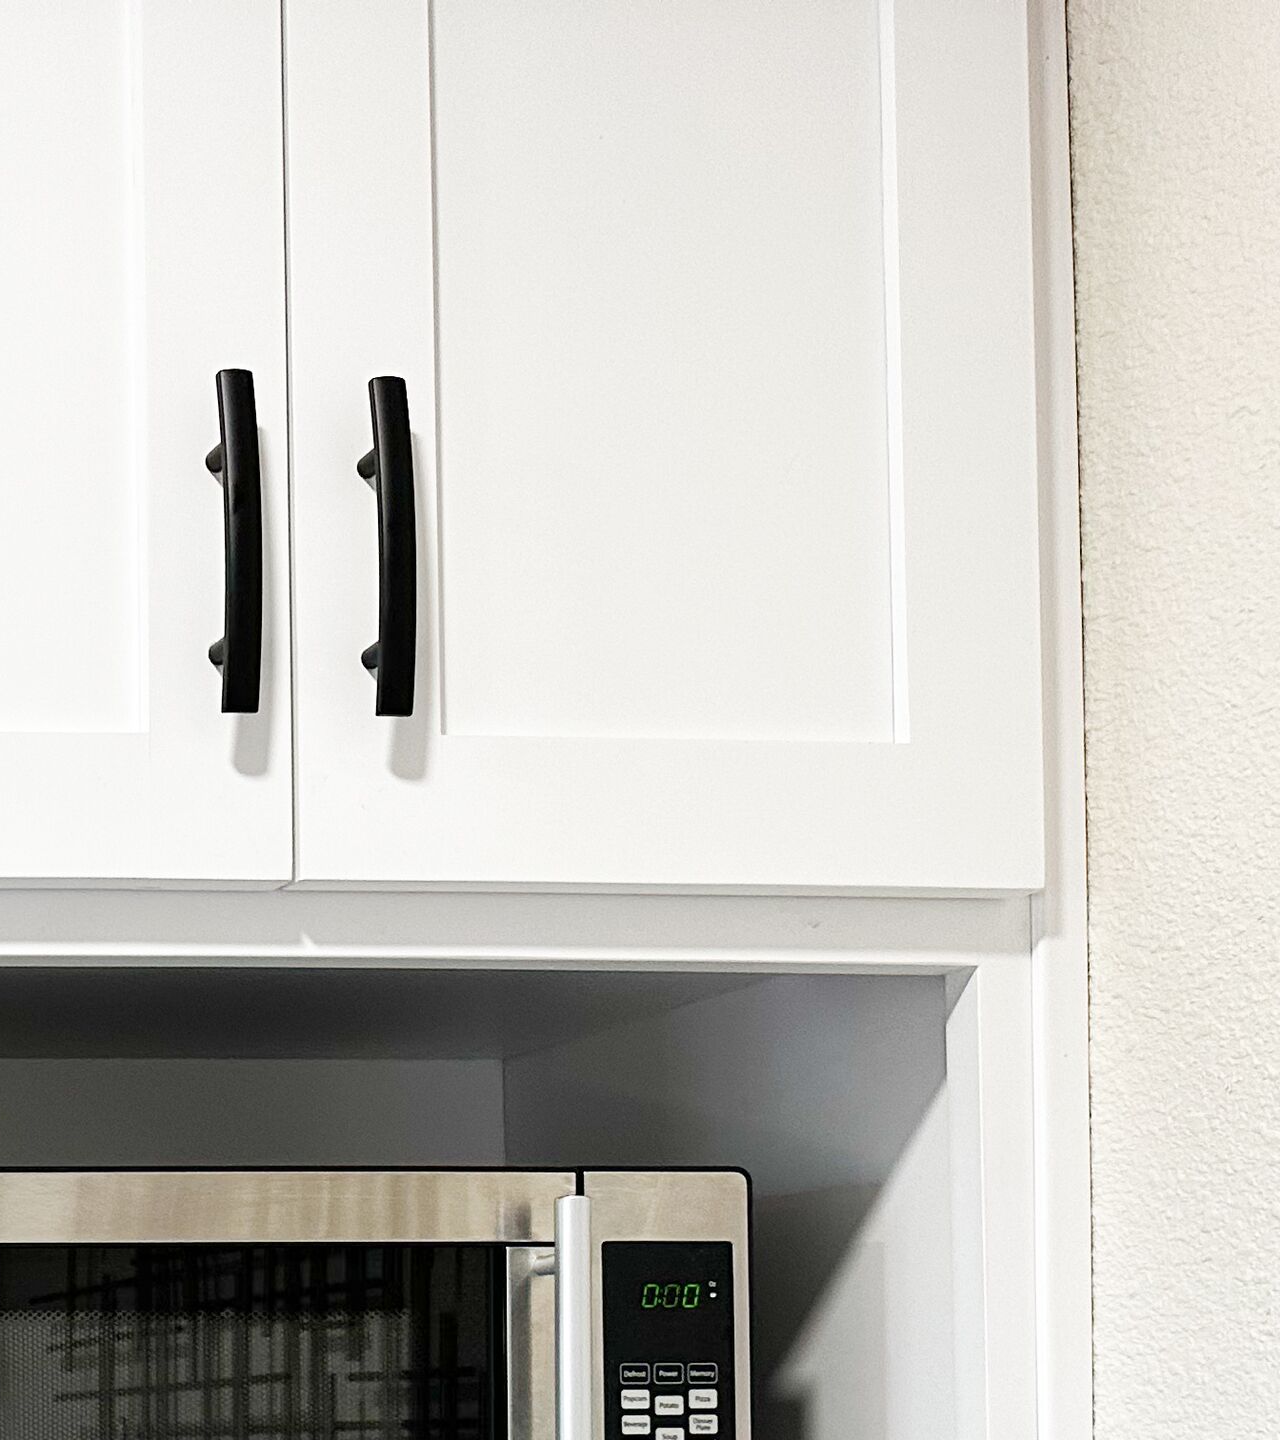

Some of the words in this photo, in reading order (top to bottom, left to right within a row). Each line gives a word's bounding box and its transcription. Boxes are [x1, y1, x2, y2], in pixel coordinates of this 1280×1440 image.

[642, 1283, 700, 1308] 0:00
[659, 1370, 679, 1378] Power
[689, 1370, 715, 1379] Memory
[662, 1433, 678, 1440] Soup
